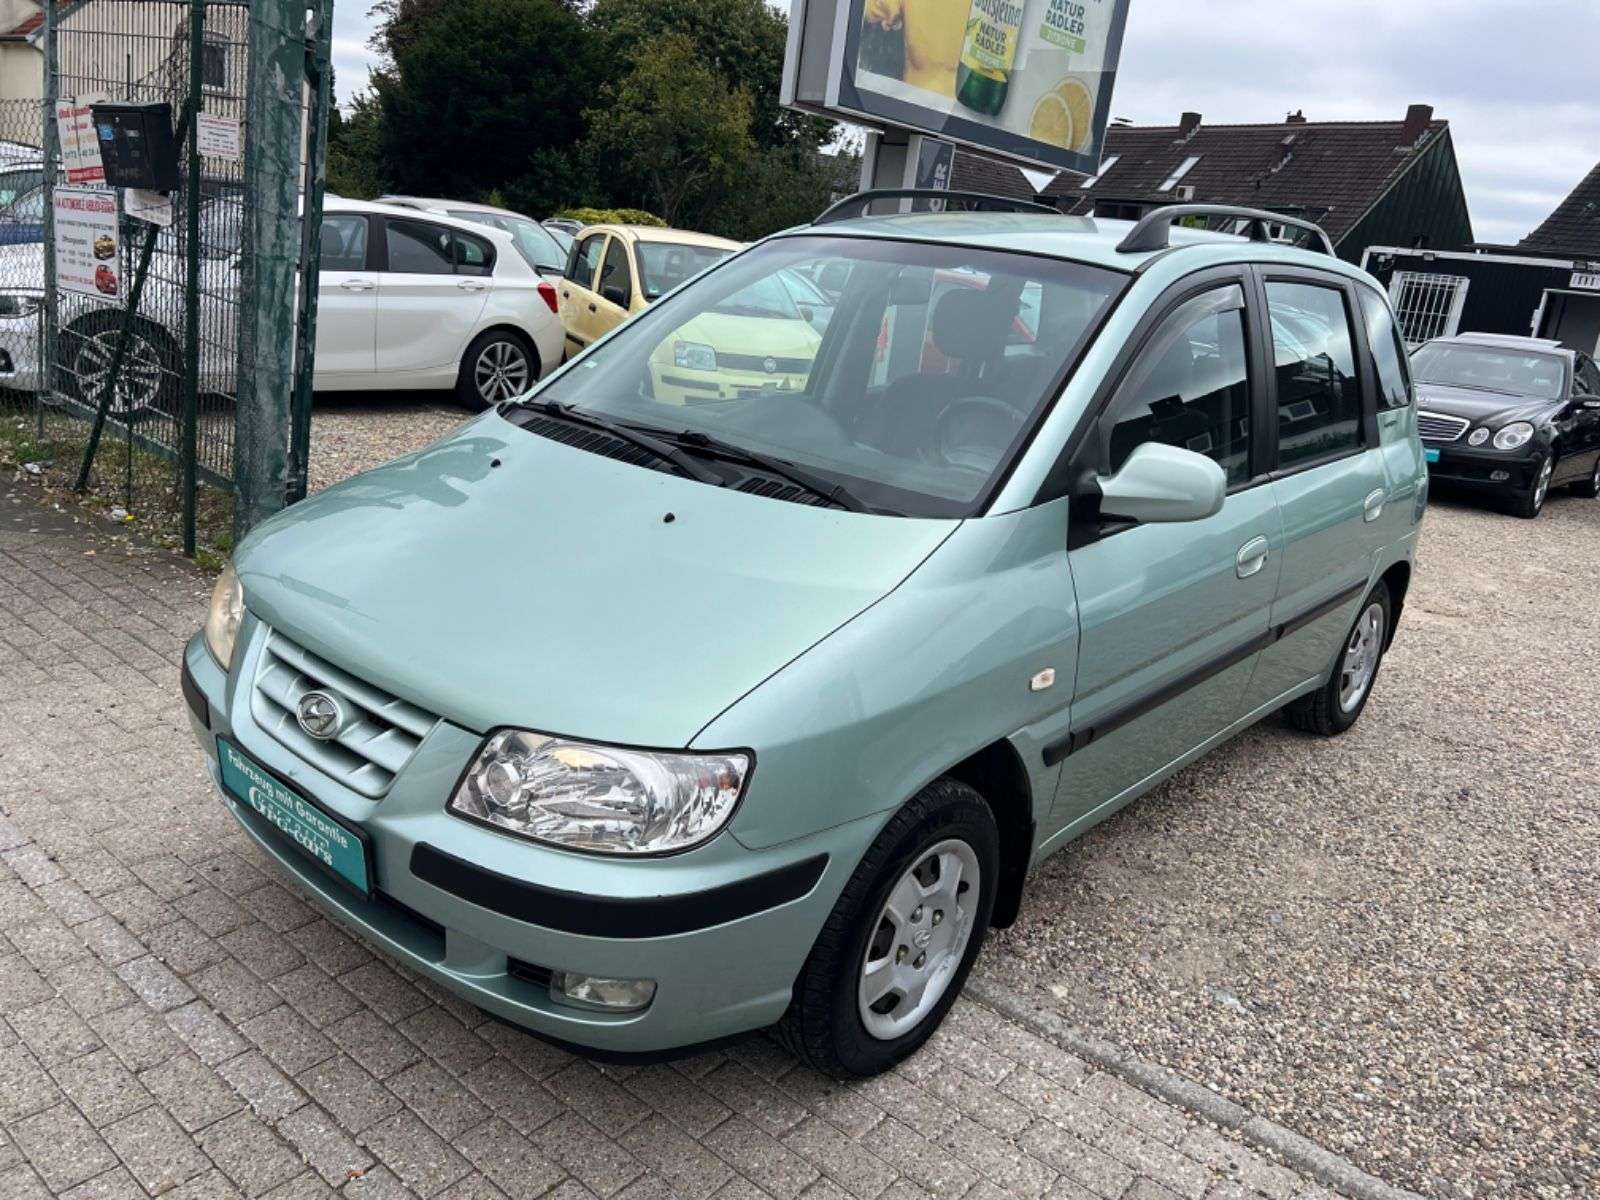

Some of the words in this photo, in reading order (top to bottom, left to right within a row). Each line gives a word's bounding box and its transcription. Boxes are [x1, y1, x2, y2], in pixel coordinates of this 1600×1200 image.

[1045, 8, 1085, 36] RADLER
[1050, 0, 1085, 20] NATUR
[980, 21, 1007, 43] NATUR
[227, 748, 274, 798] Fahrzeug
[275, 789, 293, 809] mit
[295, 800, 349, 849] Garantie
